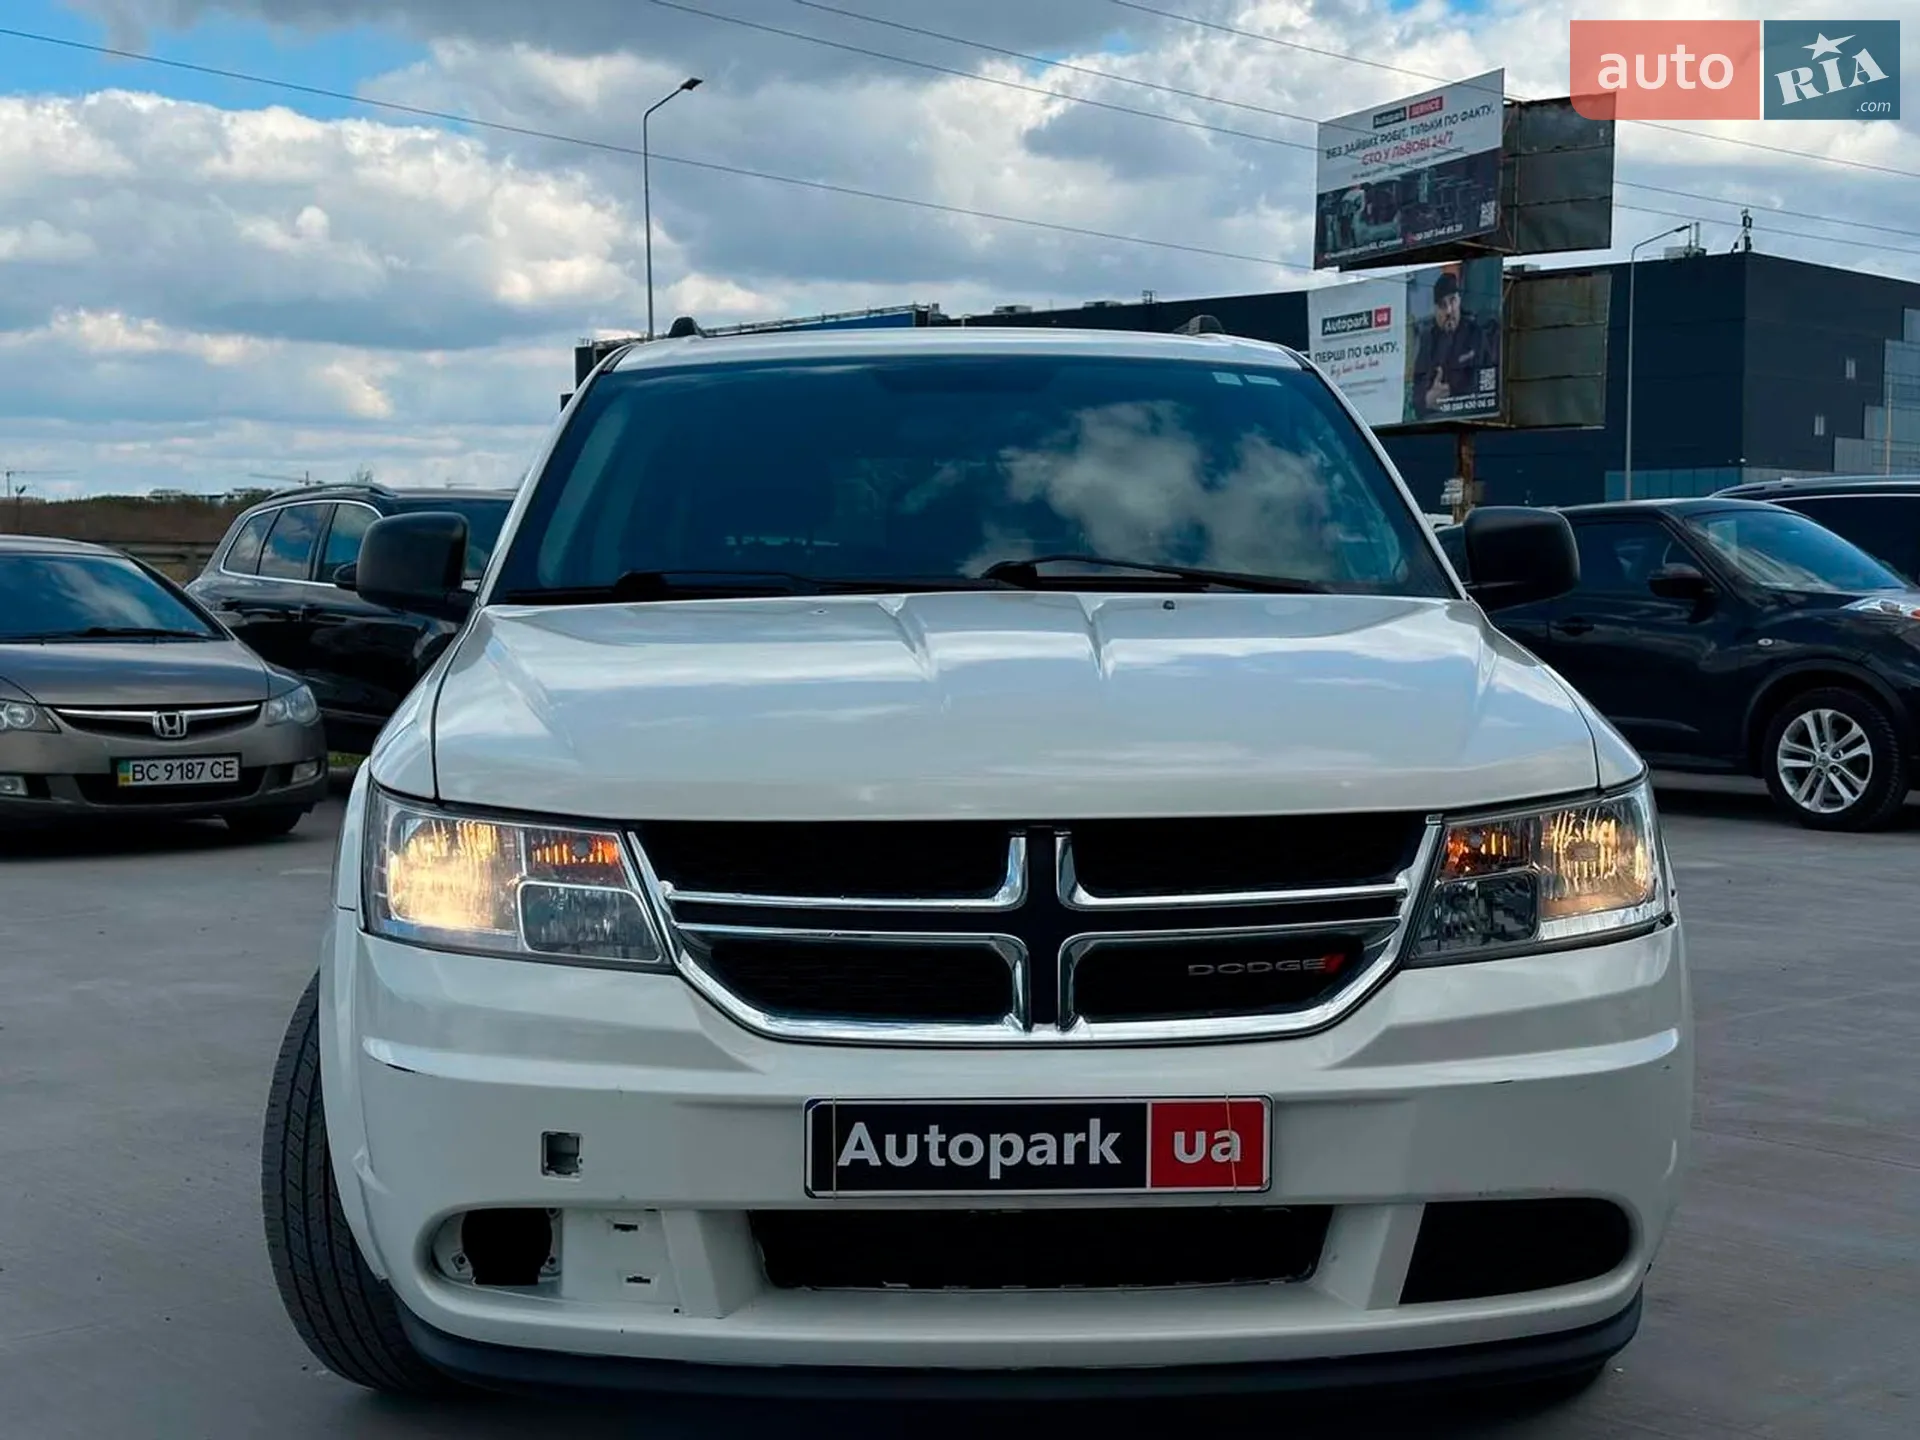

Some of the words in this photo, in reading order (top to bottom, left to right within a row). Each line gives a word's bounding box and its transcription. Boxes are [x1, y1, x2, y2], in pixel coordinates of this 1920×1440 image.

[1444, 113, 1459, 127] ПО
[1324, 312, 1370, 333] Autopark
[1315, 349, 1345, 364] ПЕРШІ
[1348, 346, 1361, 359] ПО
[1364, 341, 1400, 357] ФАКТУ.
[132, 763, 159, 781] BC
[164, 762, 205, 781] 9187
[210, 761, 235, 779] CE
[1188, 957, 1326, 976] DODGE
[837, 1118, 1122, 1180] Autopark
[1173, 1128, 1241, 1165] ua
